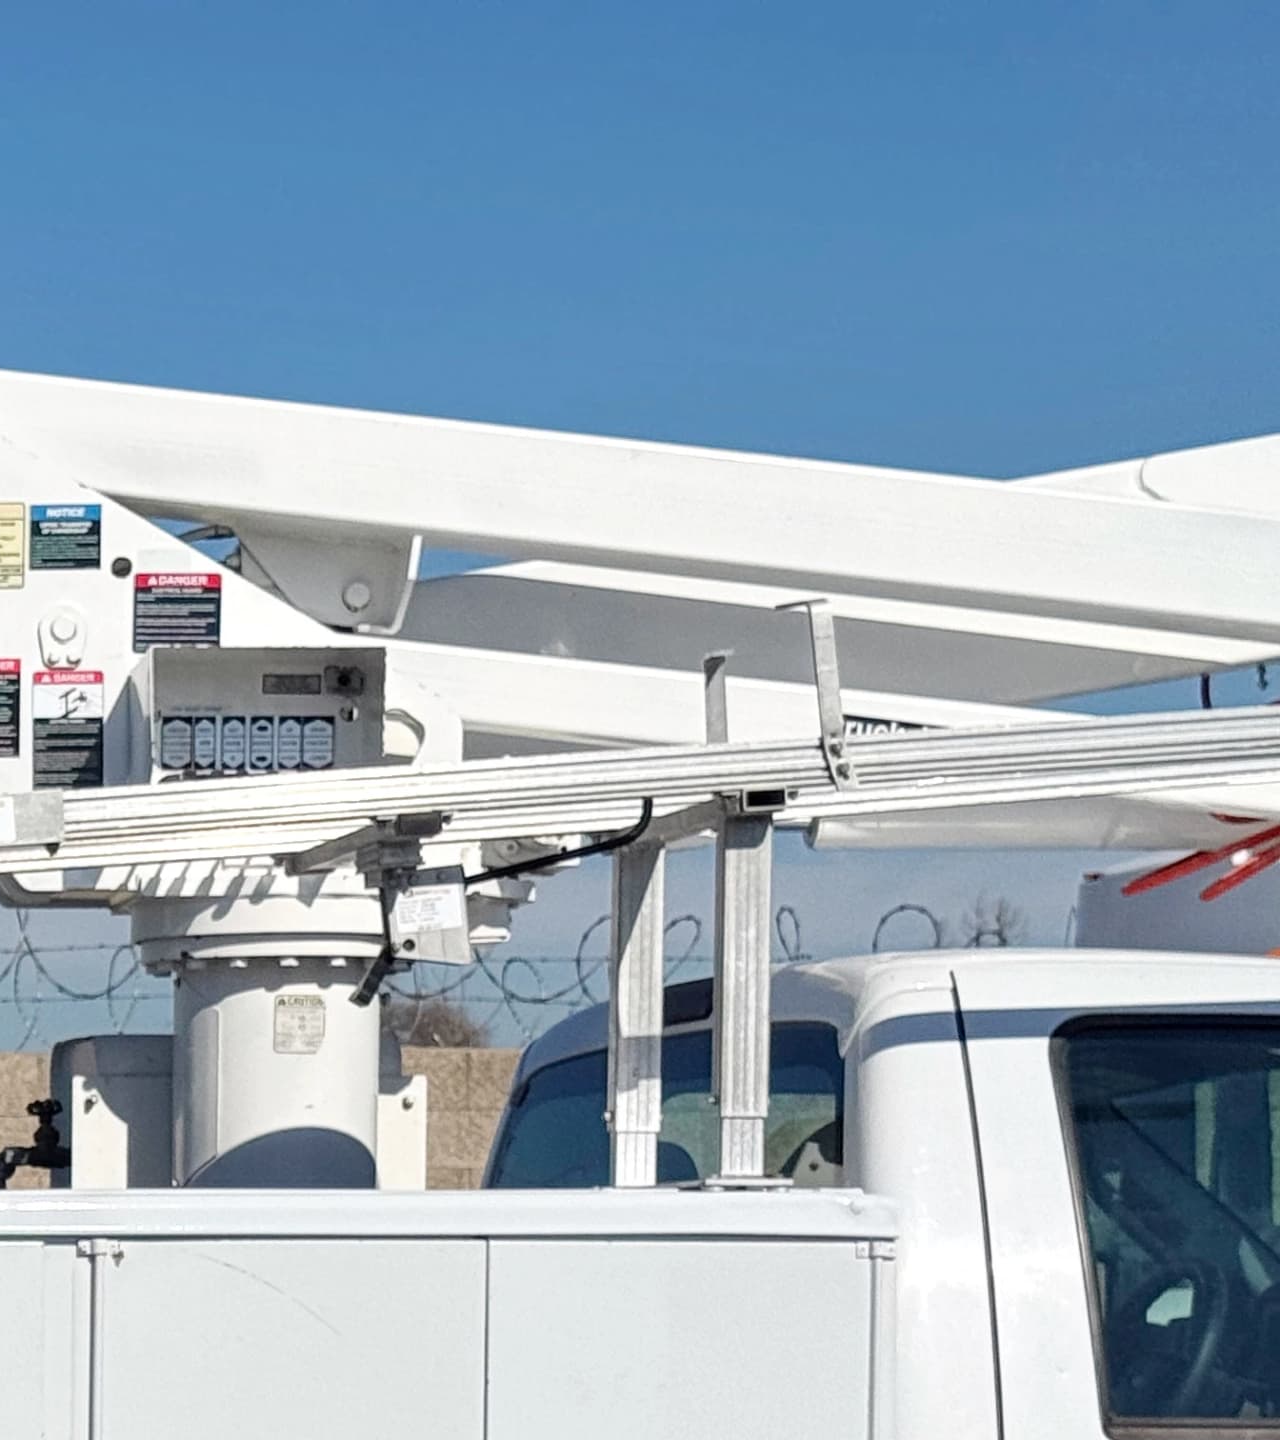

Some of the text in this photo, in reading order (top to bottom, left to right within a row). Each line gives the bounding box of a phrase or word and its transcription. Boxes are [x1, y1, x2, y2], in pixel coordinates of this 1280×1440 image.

[45, 507, 87, 518] NOTICE
[158, 575, 209, 587] DANGER
[53, 673, 97, 684] DANGER
